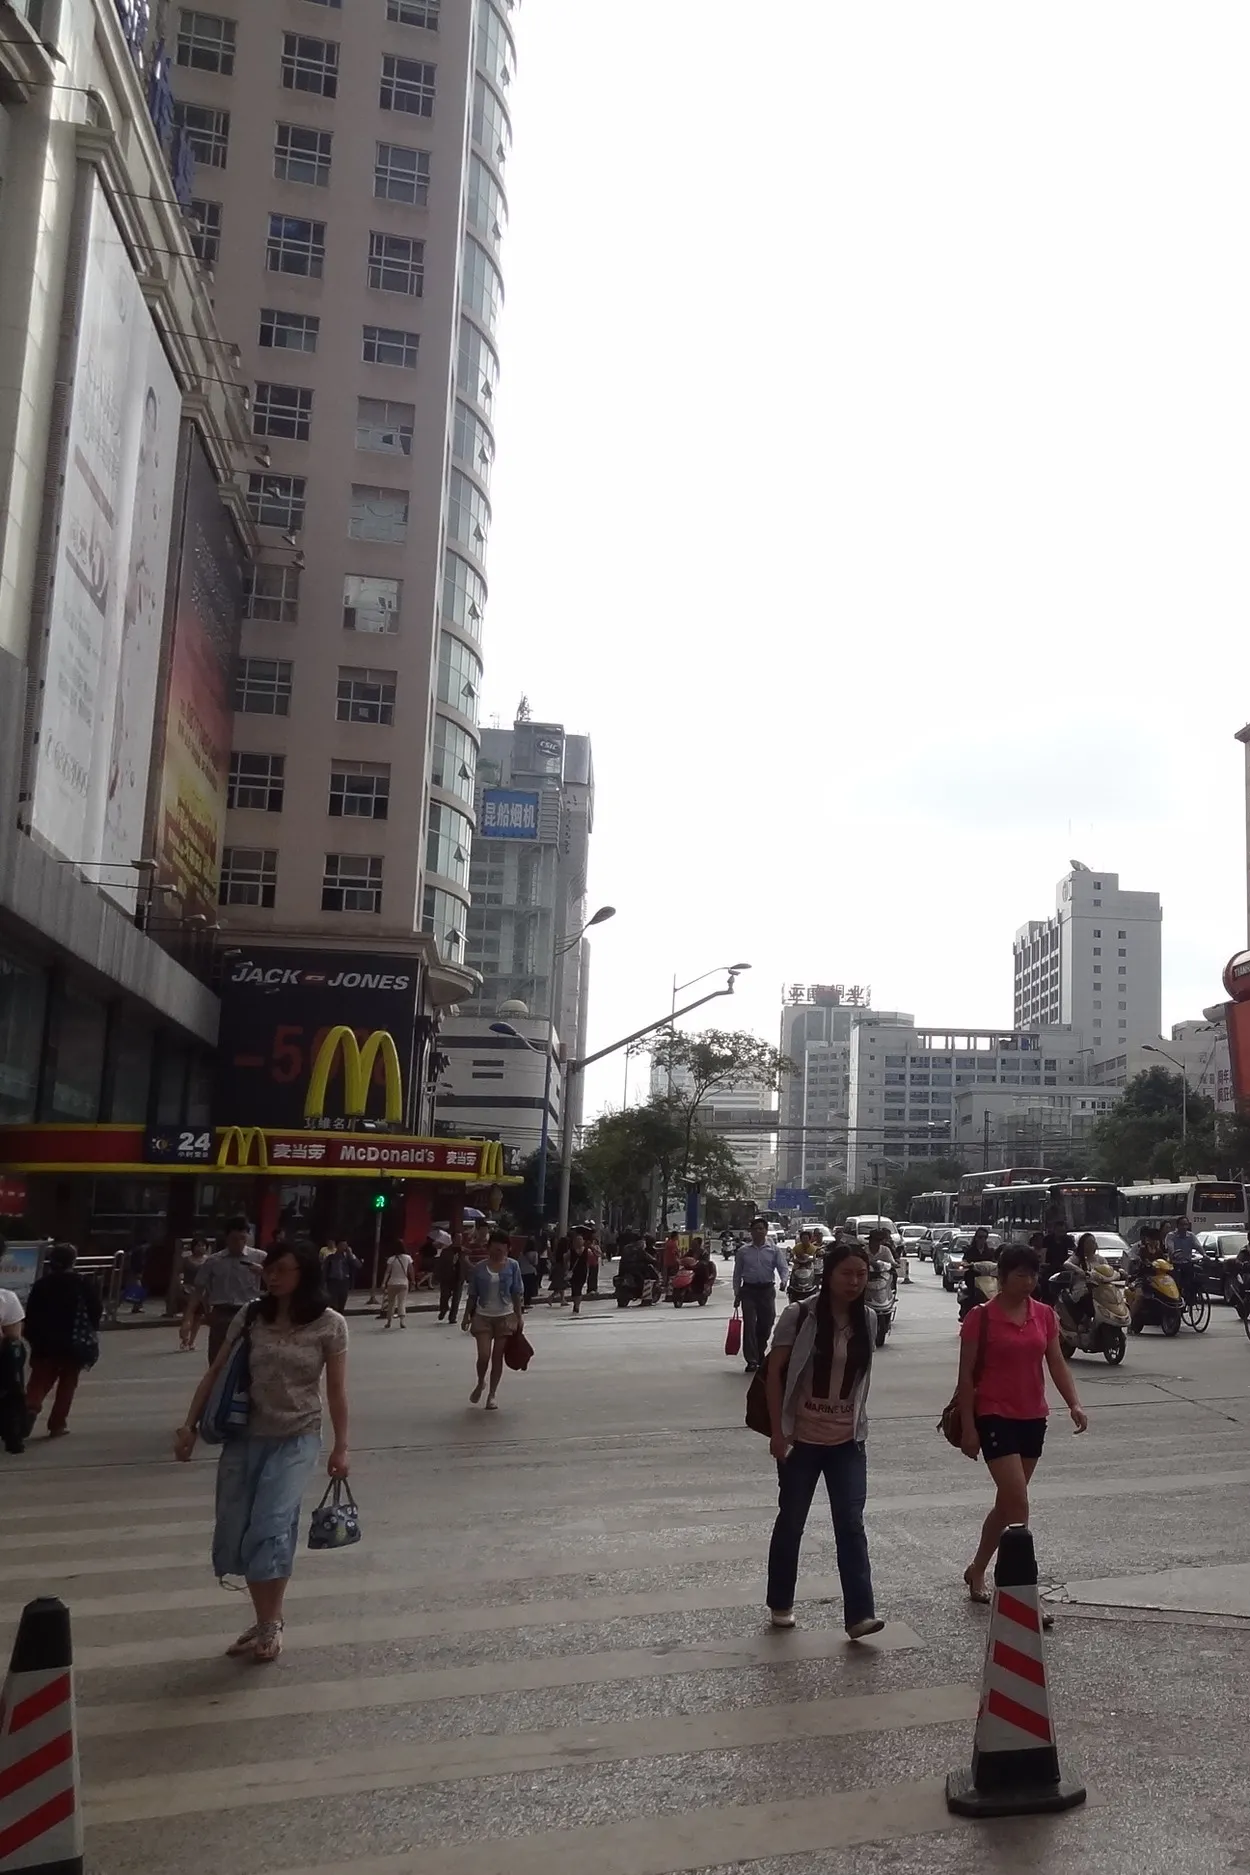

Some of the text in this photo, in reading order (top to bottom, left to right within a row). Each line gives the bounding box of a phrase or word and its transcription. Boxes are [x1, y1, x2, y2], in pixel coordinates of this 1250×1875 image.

[484, 801, 536, 828] 昆船烟机
[231, 966, 410, 990] JACK JONES
[178, 1131, 211, 1151] 24
[272, 1142, 327, 1160] 麦当劳
[339, 1144, 436, 1164] McDonald's
[445, 1150, 477, 1167] 麦当劳
[804, 1400, 839, 1414] MARINE
